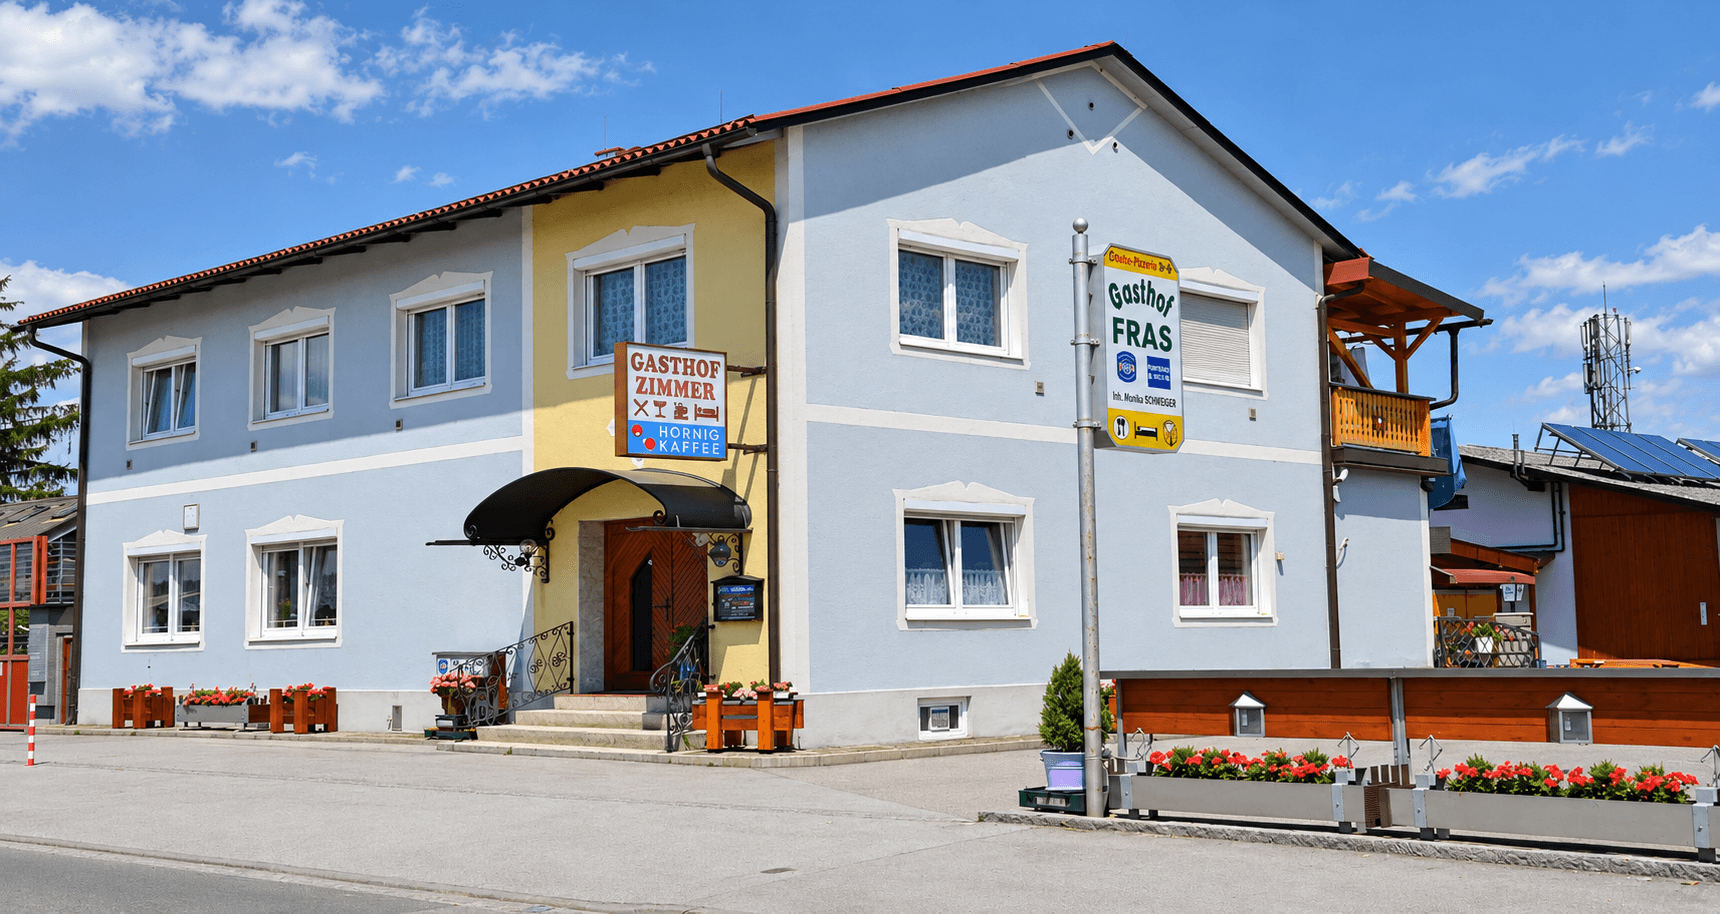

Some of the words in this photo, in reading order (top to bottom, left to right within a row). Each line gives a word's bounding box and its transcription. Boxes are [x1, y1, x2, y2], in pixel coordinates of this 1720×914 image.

[1108, 279, 1175, 318] Gasthof
[1113, 316, 1172, 352] FRAS
[631, 352, 721, 379] GASTHOF
[635, 376, 716, 400] ZIMMER
[659, 425, 720, 441] HORNIG
[659, 440, 720, 455] KAFFEE
